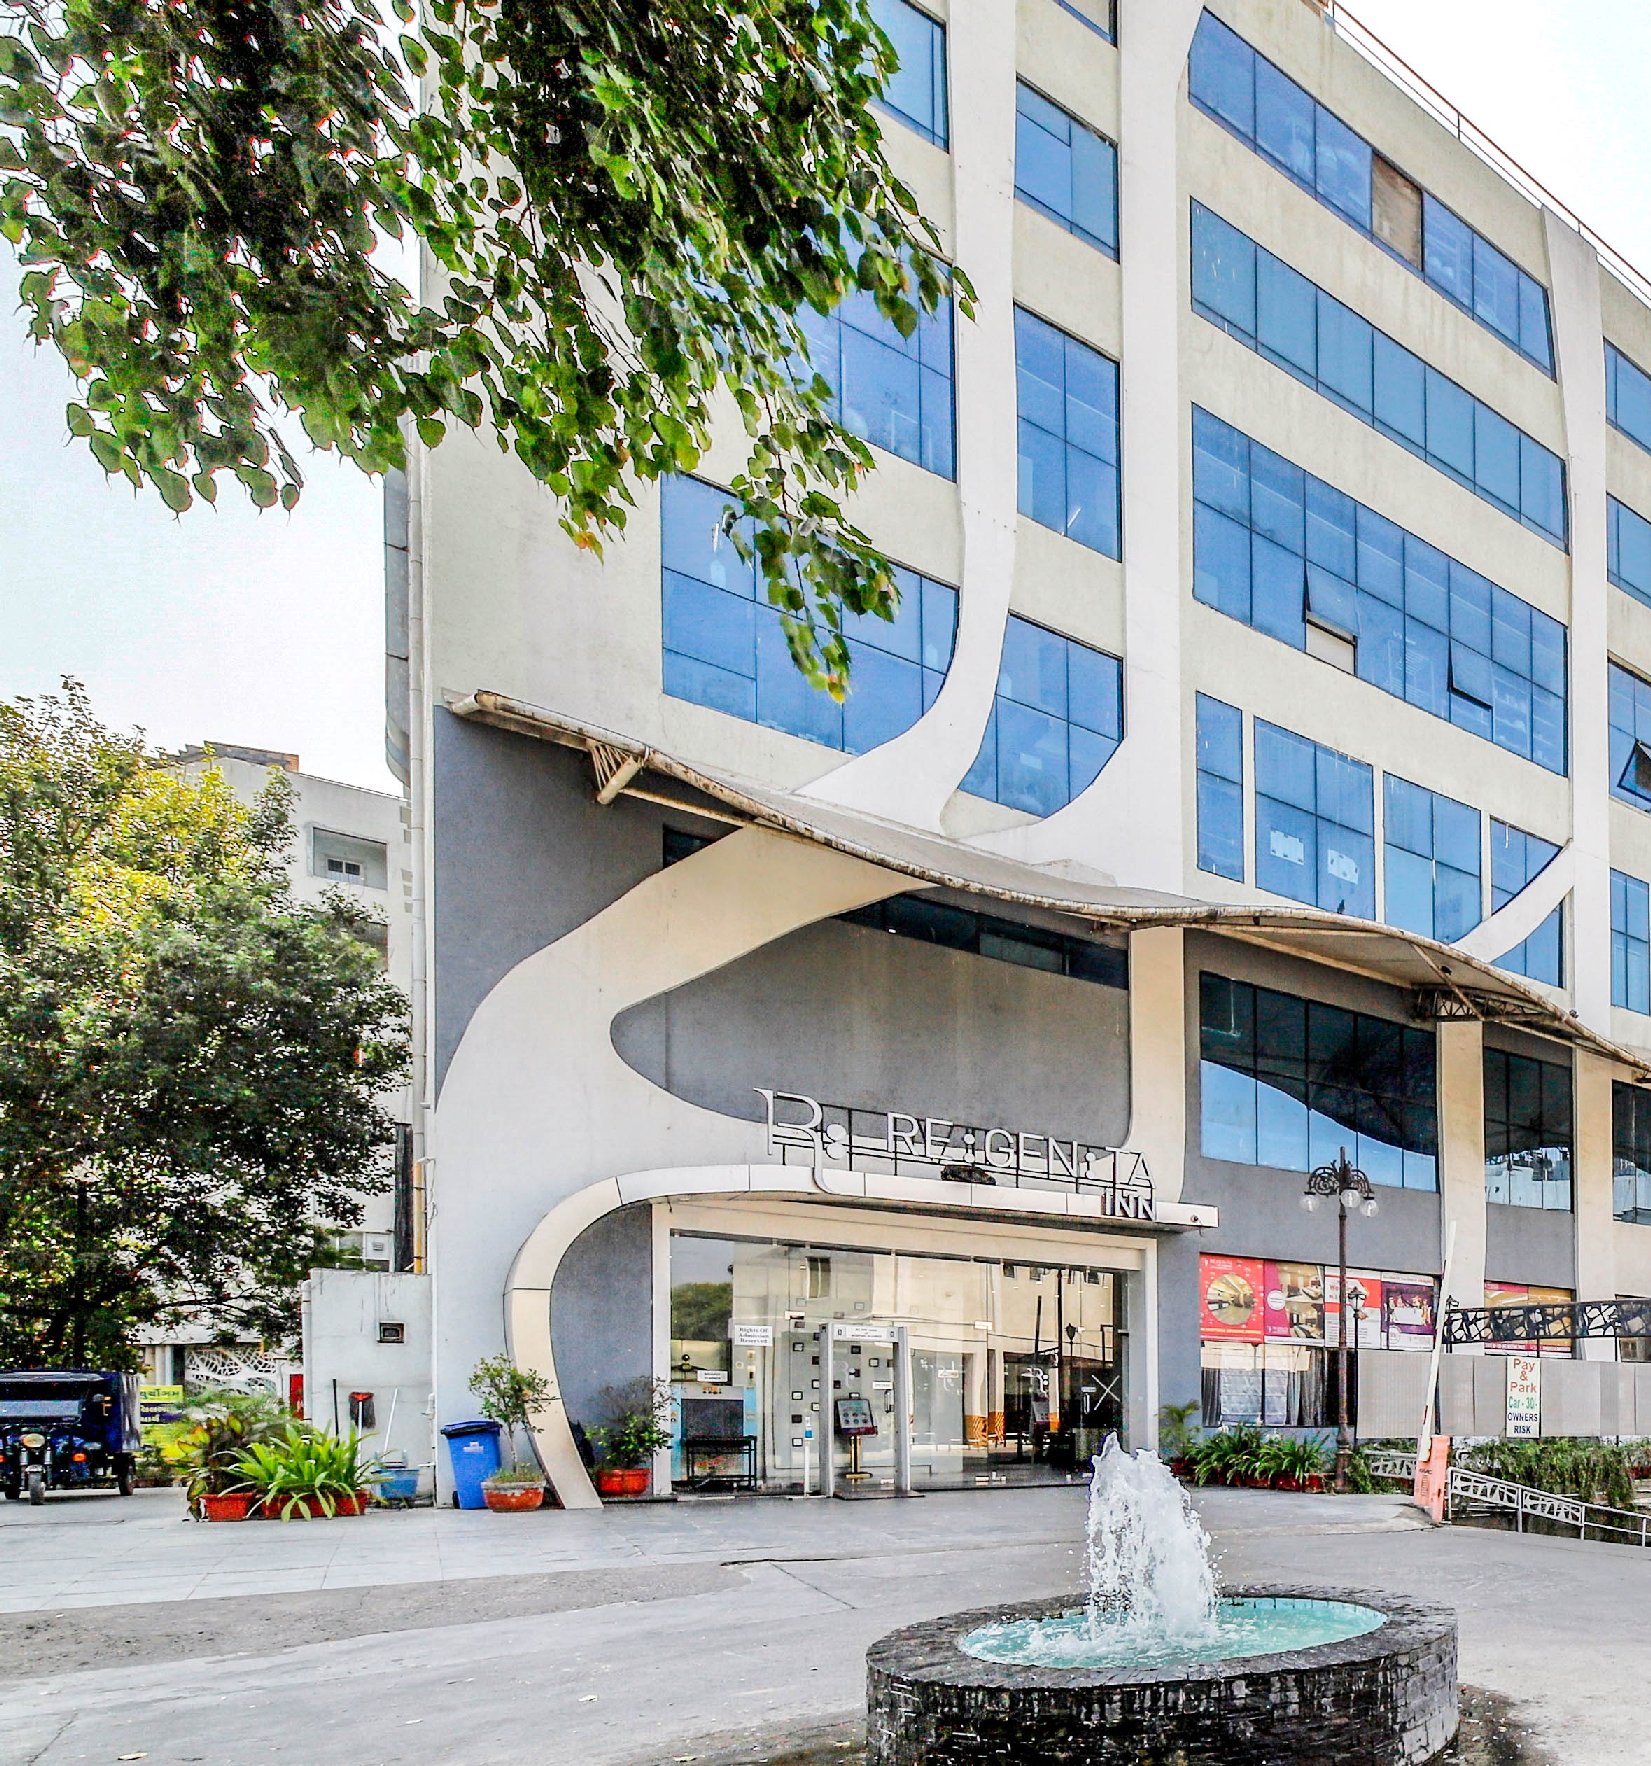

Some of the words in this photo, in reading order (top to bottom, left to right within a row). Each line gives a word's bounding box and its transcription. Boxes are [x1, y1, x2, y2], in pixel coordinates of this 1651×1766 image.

[1102, 1188, 1157, 1221] INN
[1513, 1358, 1536, 1372] Pay
[1520, 1370, 1528, 1381] &
[1510, 1381, 1537, 1393] Park
[1508, 1396, 1520, 1409] Car
[1507, 1412, 1538, 1422] OWNERS
[1513, 1425, 1531, 1434] RISK
